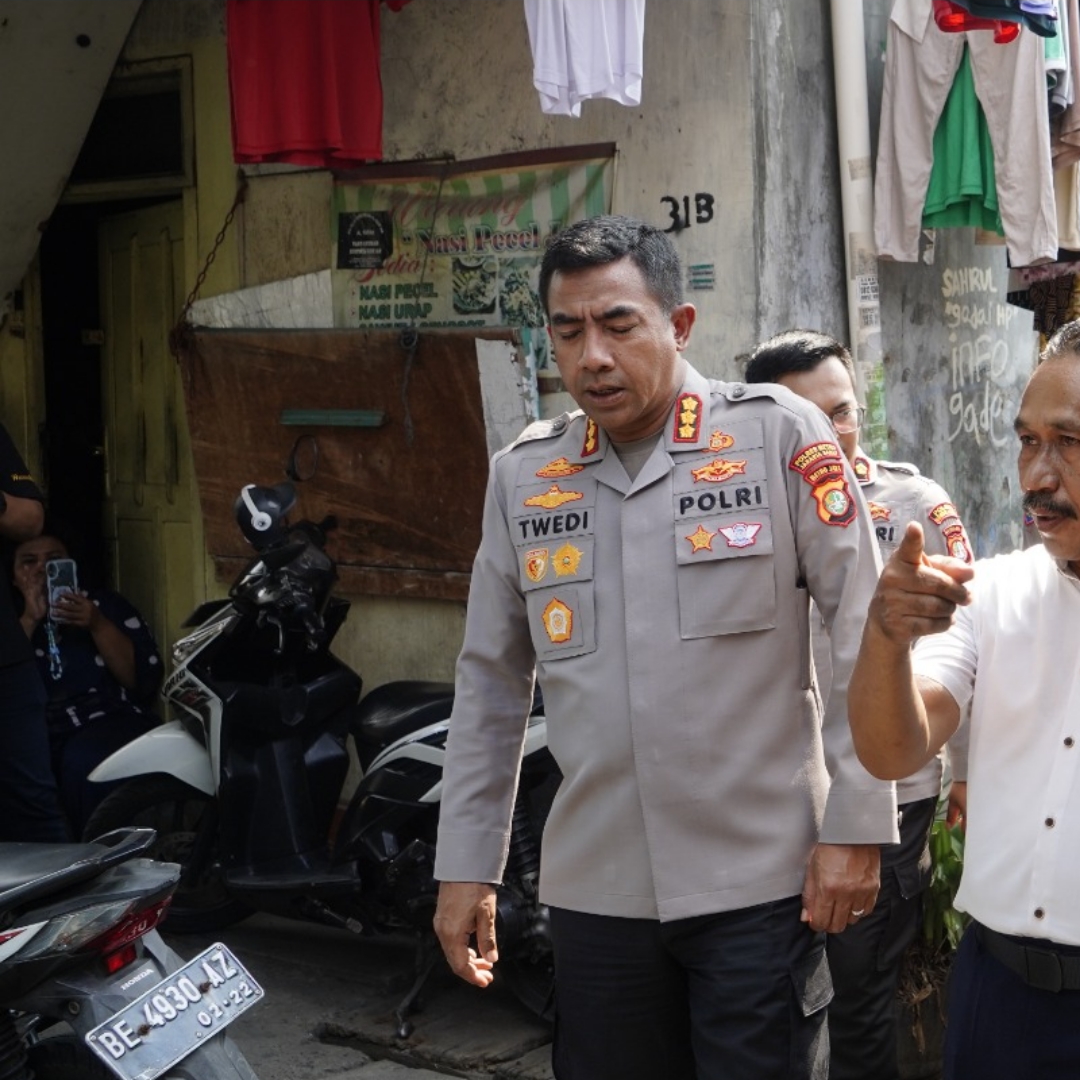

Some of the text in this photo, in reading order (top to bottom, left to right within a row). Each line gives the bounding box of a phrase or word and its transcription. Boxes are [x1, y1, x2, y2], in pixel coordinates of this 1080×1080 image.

[660, 193, 714, 233] 31B
[416, 226, 468, 254] Nasi
[474, 222, 542, 253] Pecel
[359, 282, 438, 301] NASI PECEL
[359, 302, 433, 320] NASI URAP
[680, 486, 761, 515] POLRI
[519, 511, 588, 538] TWEDI
[121, 968, 154, 990] HONDA
[99, 951, 237, 1060] BE 4930 AZ
